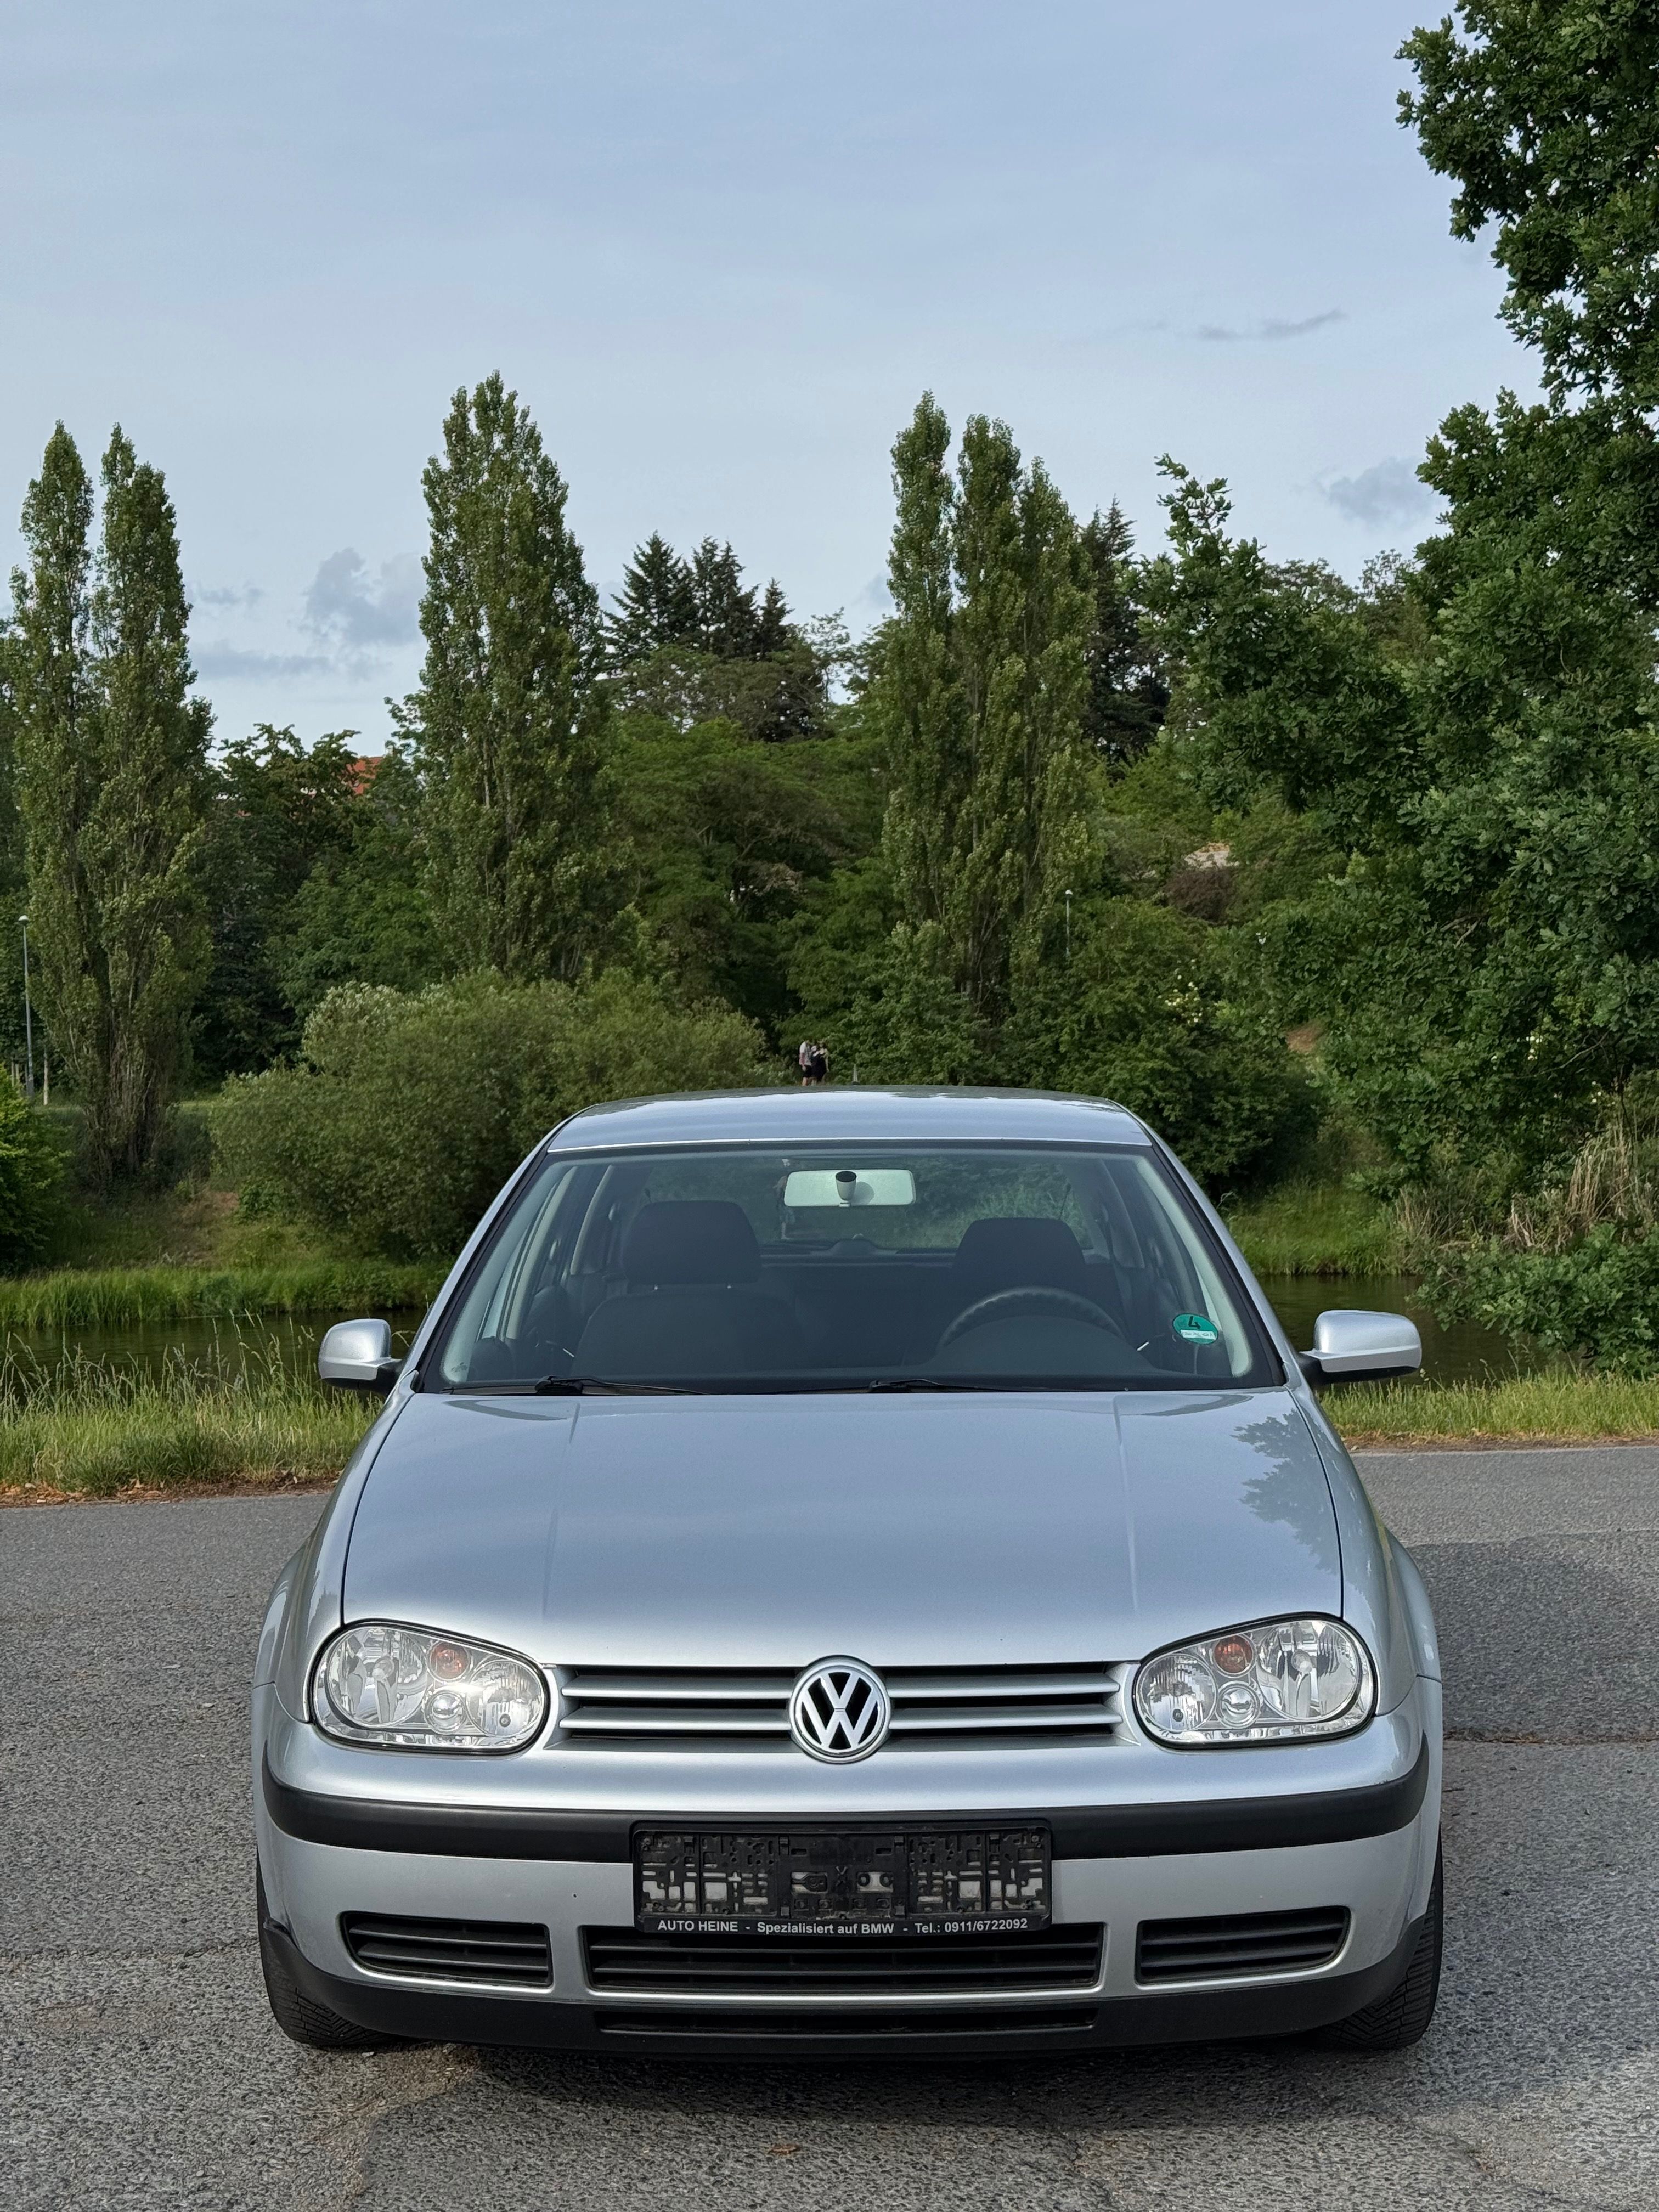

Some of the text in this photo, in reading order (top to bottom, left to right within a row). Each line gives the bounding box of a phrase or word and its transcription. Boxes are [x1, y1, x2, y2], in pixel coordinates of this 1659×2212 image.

[1188, 1316, 1201, 1330] 4
[796, 1667, 884, 1753] VW
[657, 1920, 695, 1931] AUTO
[698, 1920, 738, 1932] HEINE
[757, 1921, 834, 1935] Spezialisiert
[837, 1923, 858, 1934] auf
[861, 1923, 894, 1934] BMW
[914, 1922, 940, 1933] Tel.:
[944, 1918, 1028, 1933] 0911/6722092
